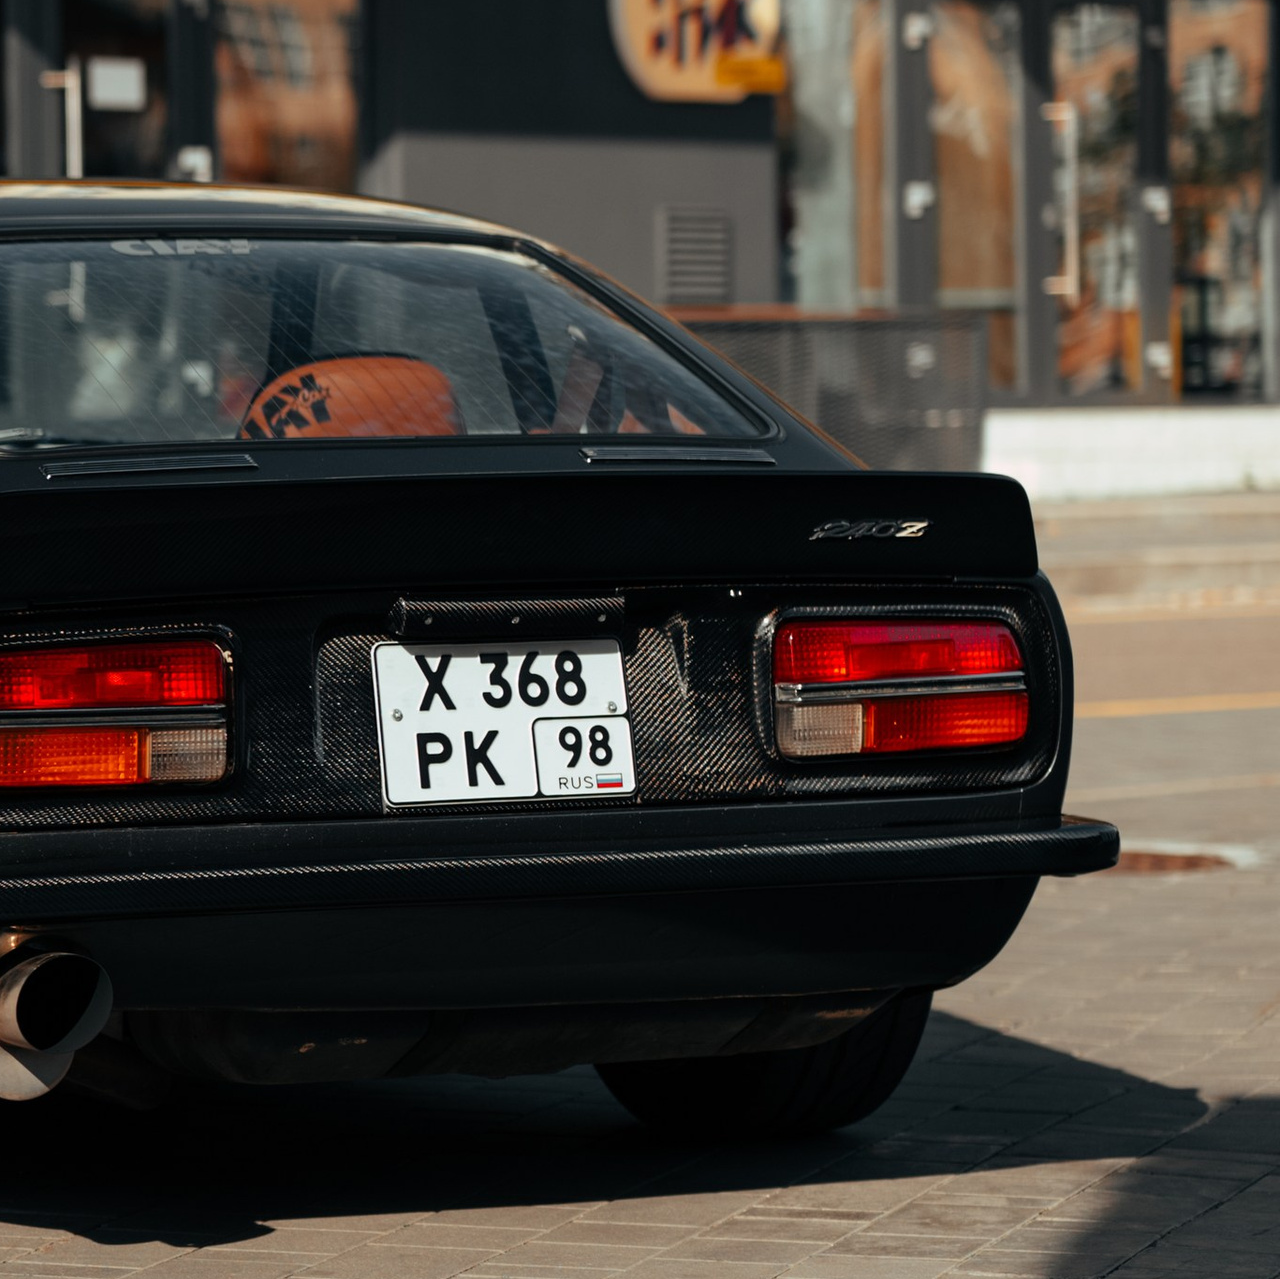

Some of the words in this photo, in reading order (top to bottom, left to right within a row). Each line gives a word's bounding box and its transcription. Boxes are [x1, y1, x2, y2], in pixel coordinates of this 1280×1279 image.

[479, 650, 587, 709] 368
[558, 724, 613, 769] 98
[558, 776, 594, 791] RUS
